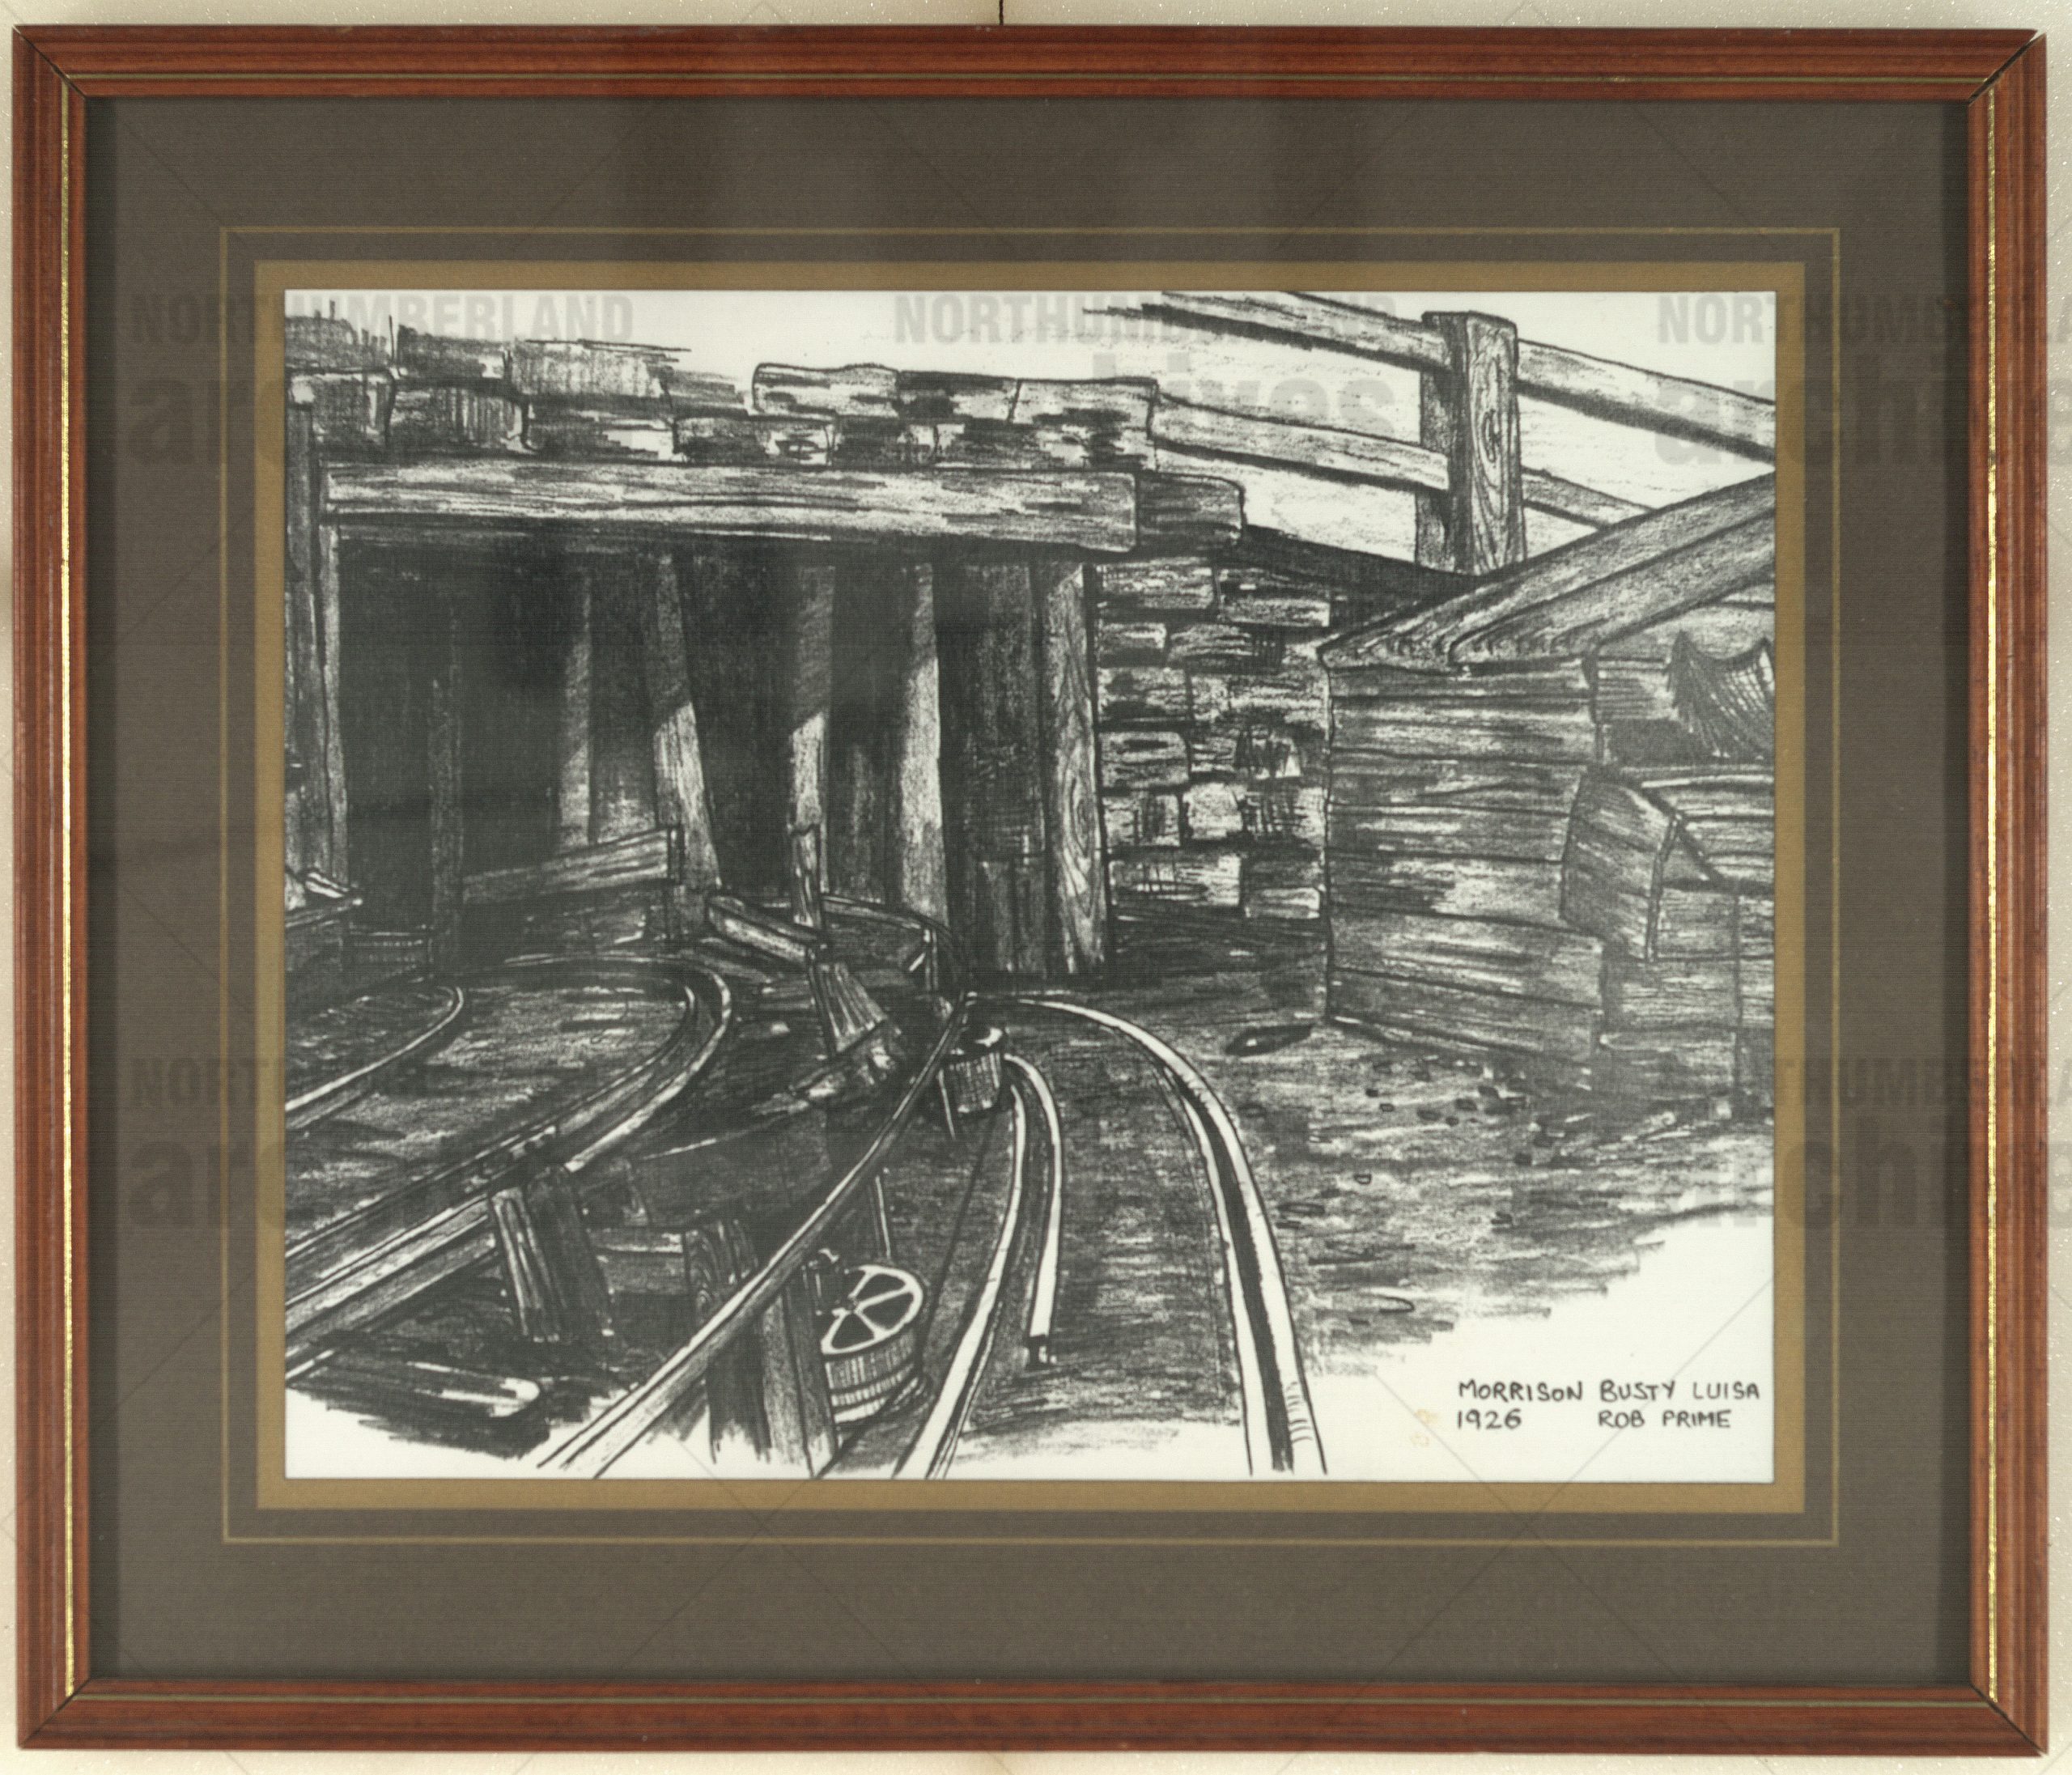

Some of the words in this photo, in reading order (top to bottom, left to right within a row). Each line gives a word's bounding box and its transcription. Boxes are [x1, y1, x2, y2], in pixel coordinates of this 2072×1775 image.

[1458, 1379, 1582, 1403] MORRISON
[1600, 1379, 1675, 1403] BUSTY
[1693, 1381, 1760, 1399] LUISA
[1458, 1408, 1522, 1429] 1926
[1599, 1409, 1645, 1429] ROB
[1662, 1409, 1731, 1428] PRIME
